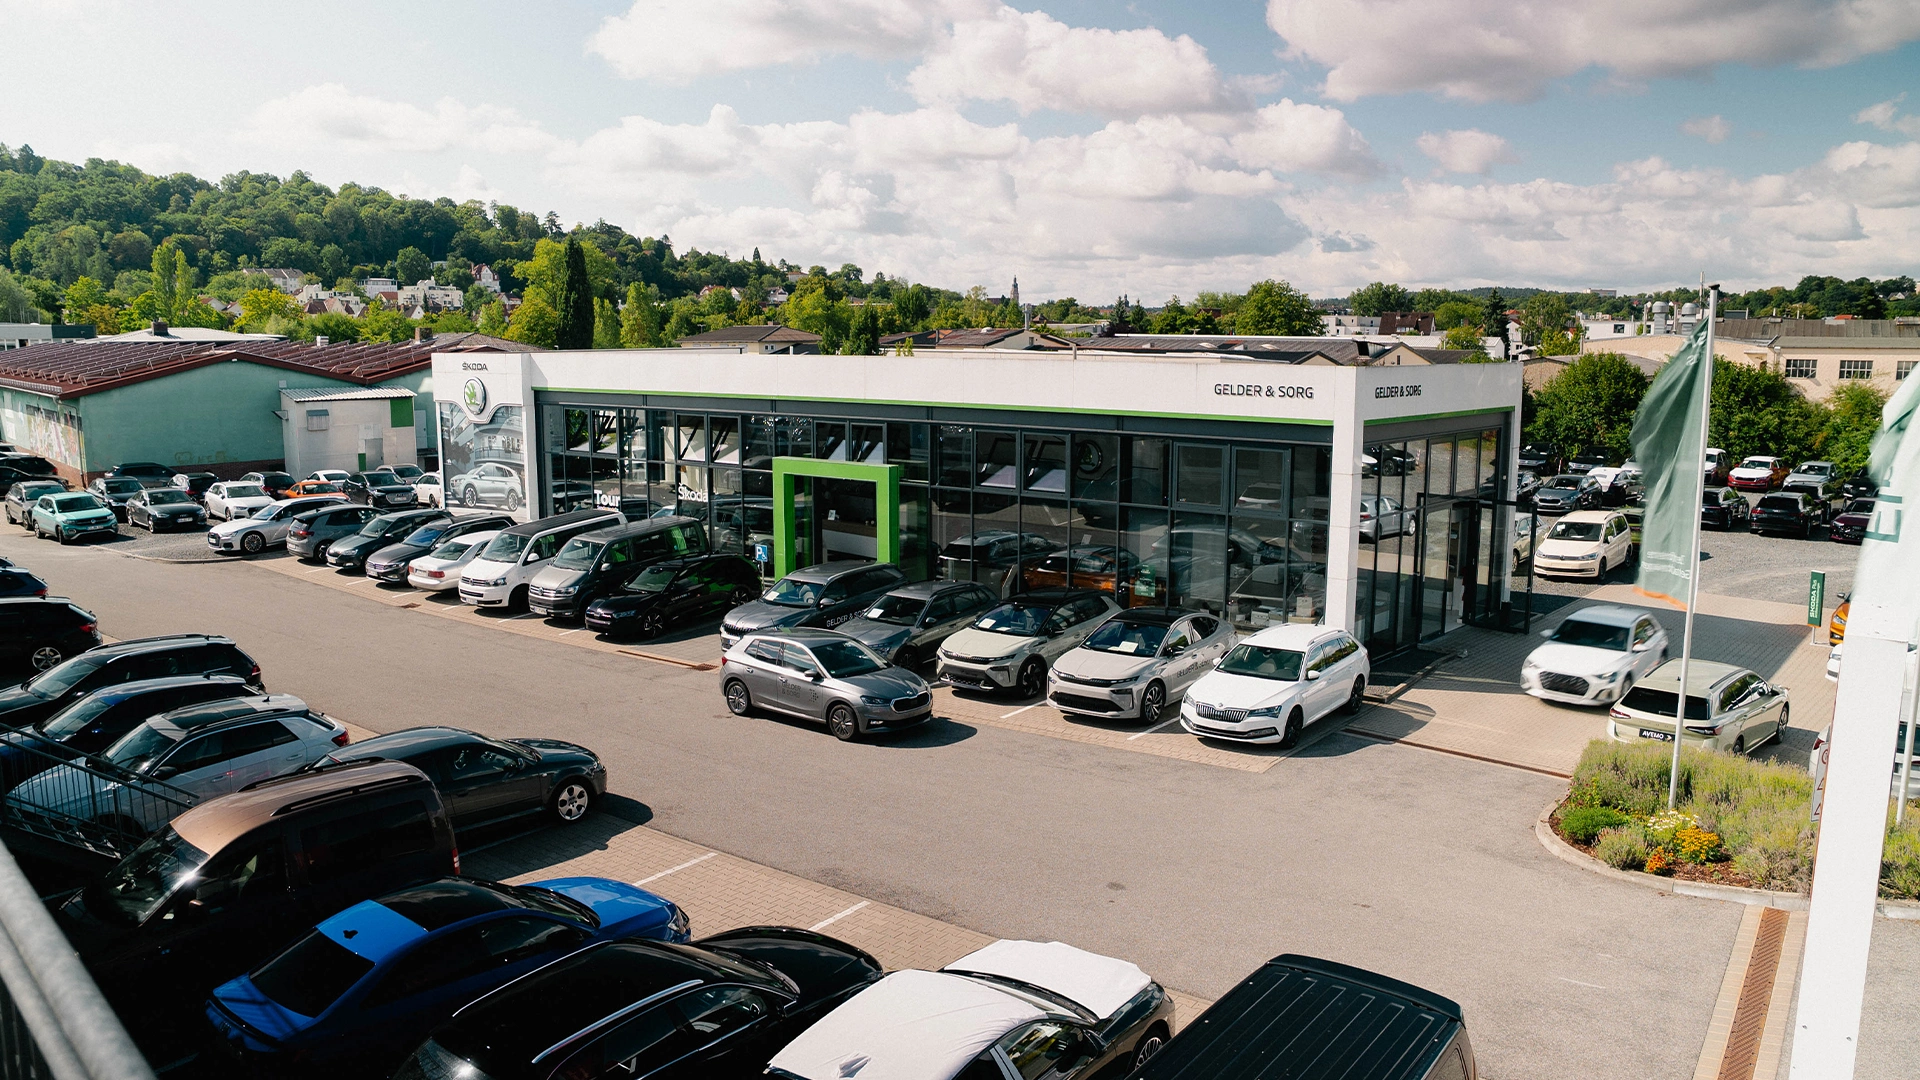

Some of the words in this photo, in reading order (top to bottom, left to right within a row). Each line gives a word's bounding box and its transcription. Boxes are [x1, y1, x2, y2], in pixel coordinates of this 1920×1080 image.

[462, 362, 488, 371] ŠKODA
[1214, 383, 1262, 398] GELDER
[1265, 385, 1275, 398] &
[1278, 386, 1314, 399] SORG
[1375, 386, 1399, 399] GELDER
[1400, 386, 1405, 397] &
[1405, 384, 1422, 397] SORG
[594, 489, 621, 507] Tour
[756, 546, 763, 559] P
[1642, 730, 1664, 739] AVEMO
